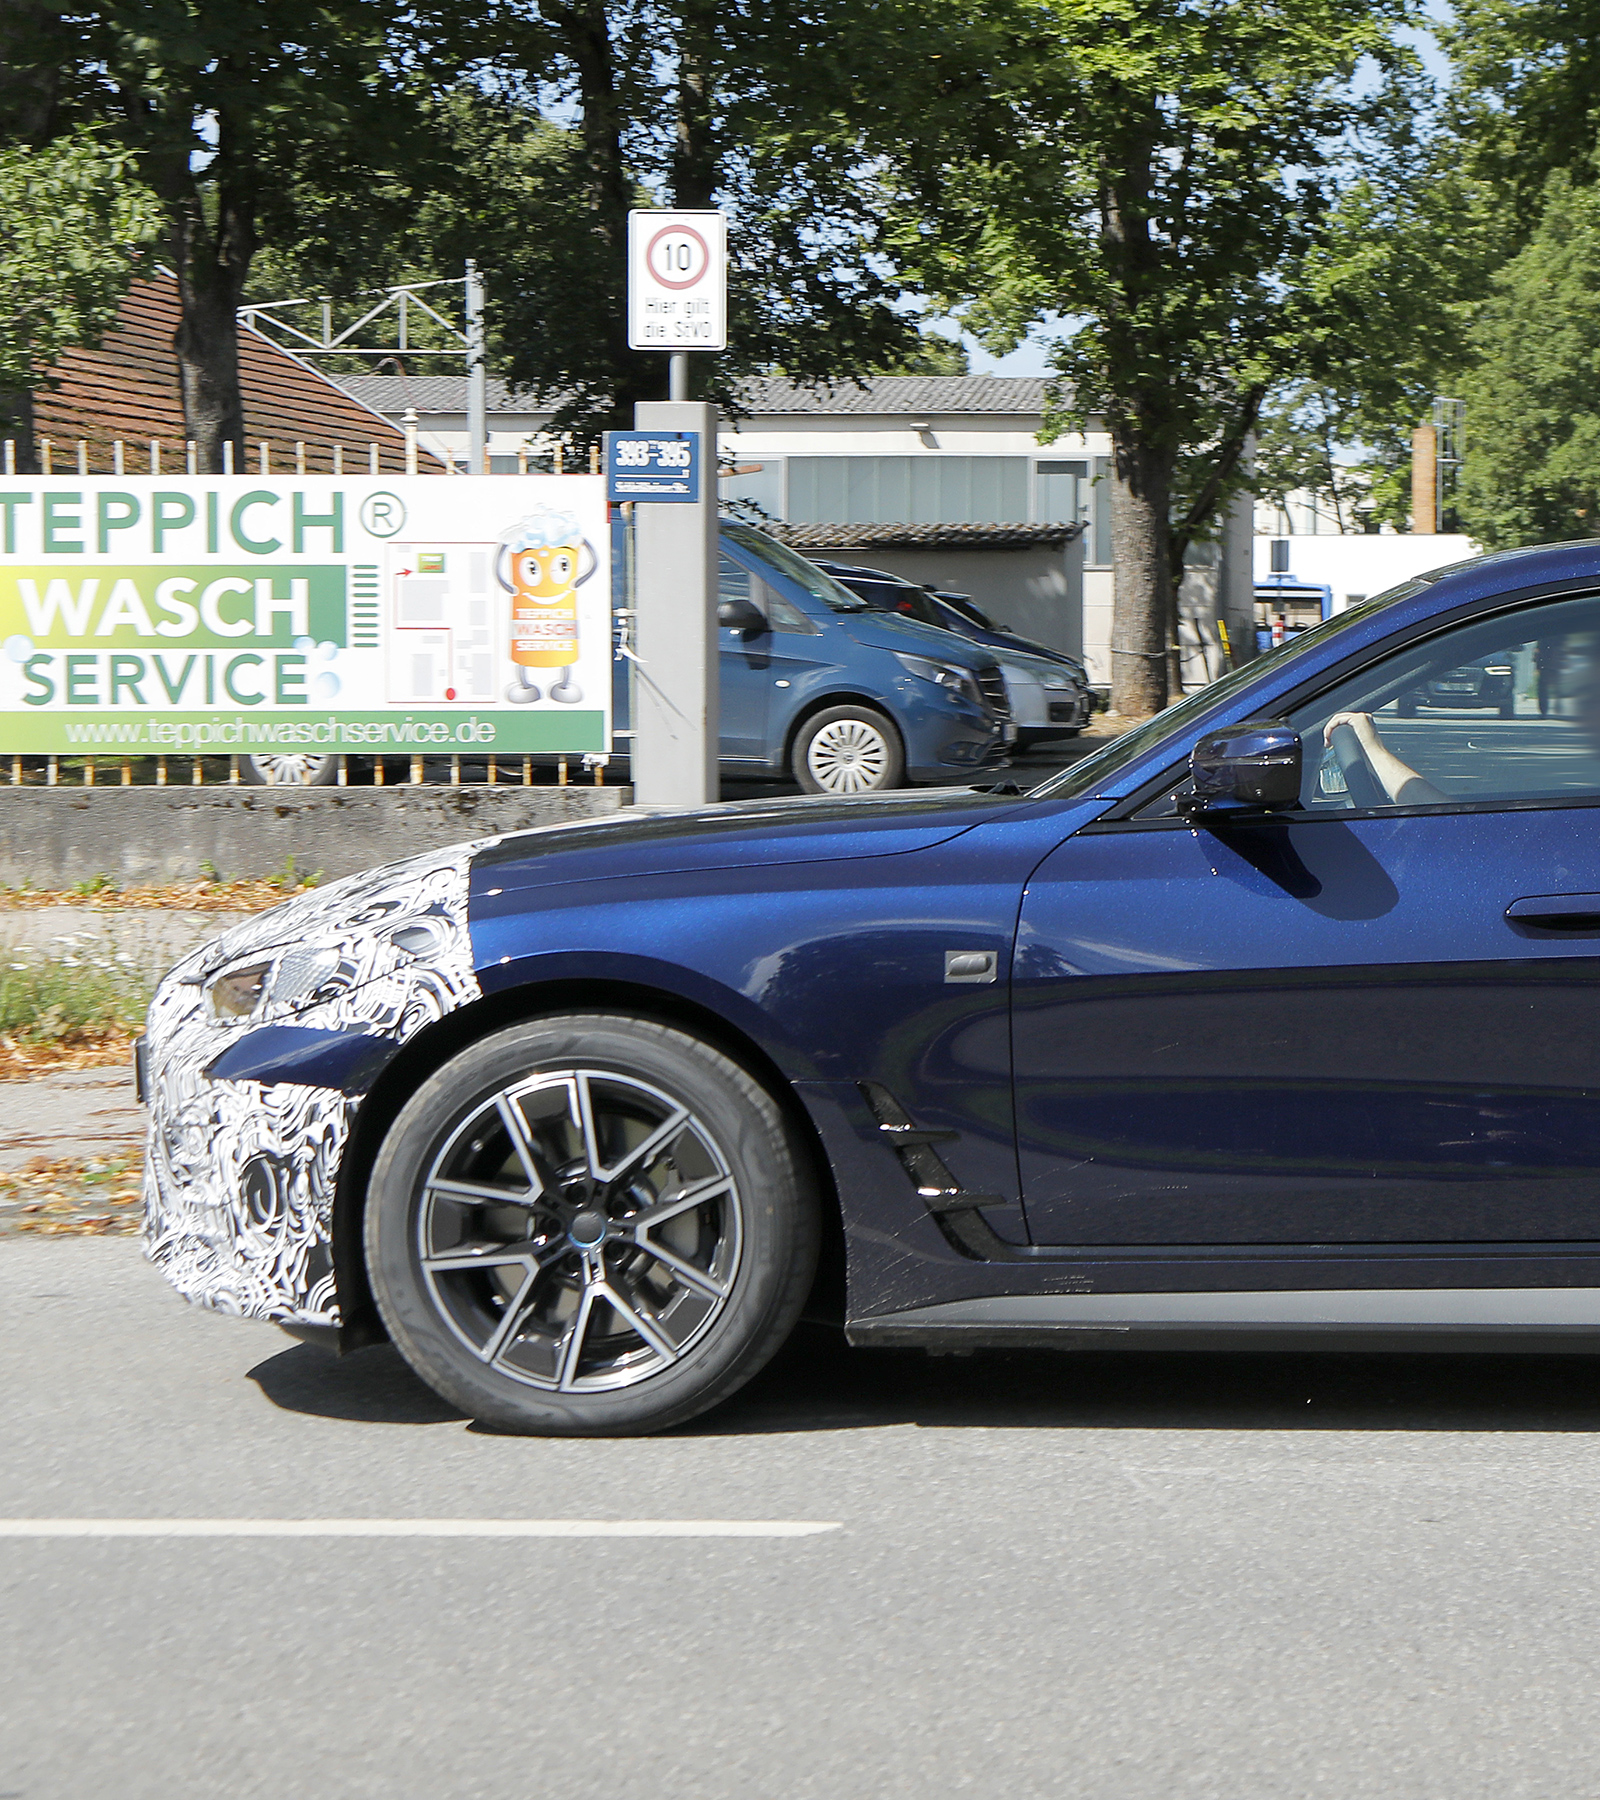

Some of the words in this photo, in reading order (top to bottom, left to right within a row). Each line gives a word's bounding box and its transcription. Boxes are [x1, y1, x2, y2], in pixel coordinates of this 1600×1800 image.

[665, 243, 691, 271] 10
[16, 576, 310, 638] WASCH
[516, 623, 576, 636] WASCH
[22, 653, 310, 706] SERVICE
[65, 716, 496, 749] www.teppichwaschservice.de
